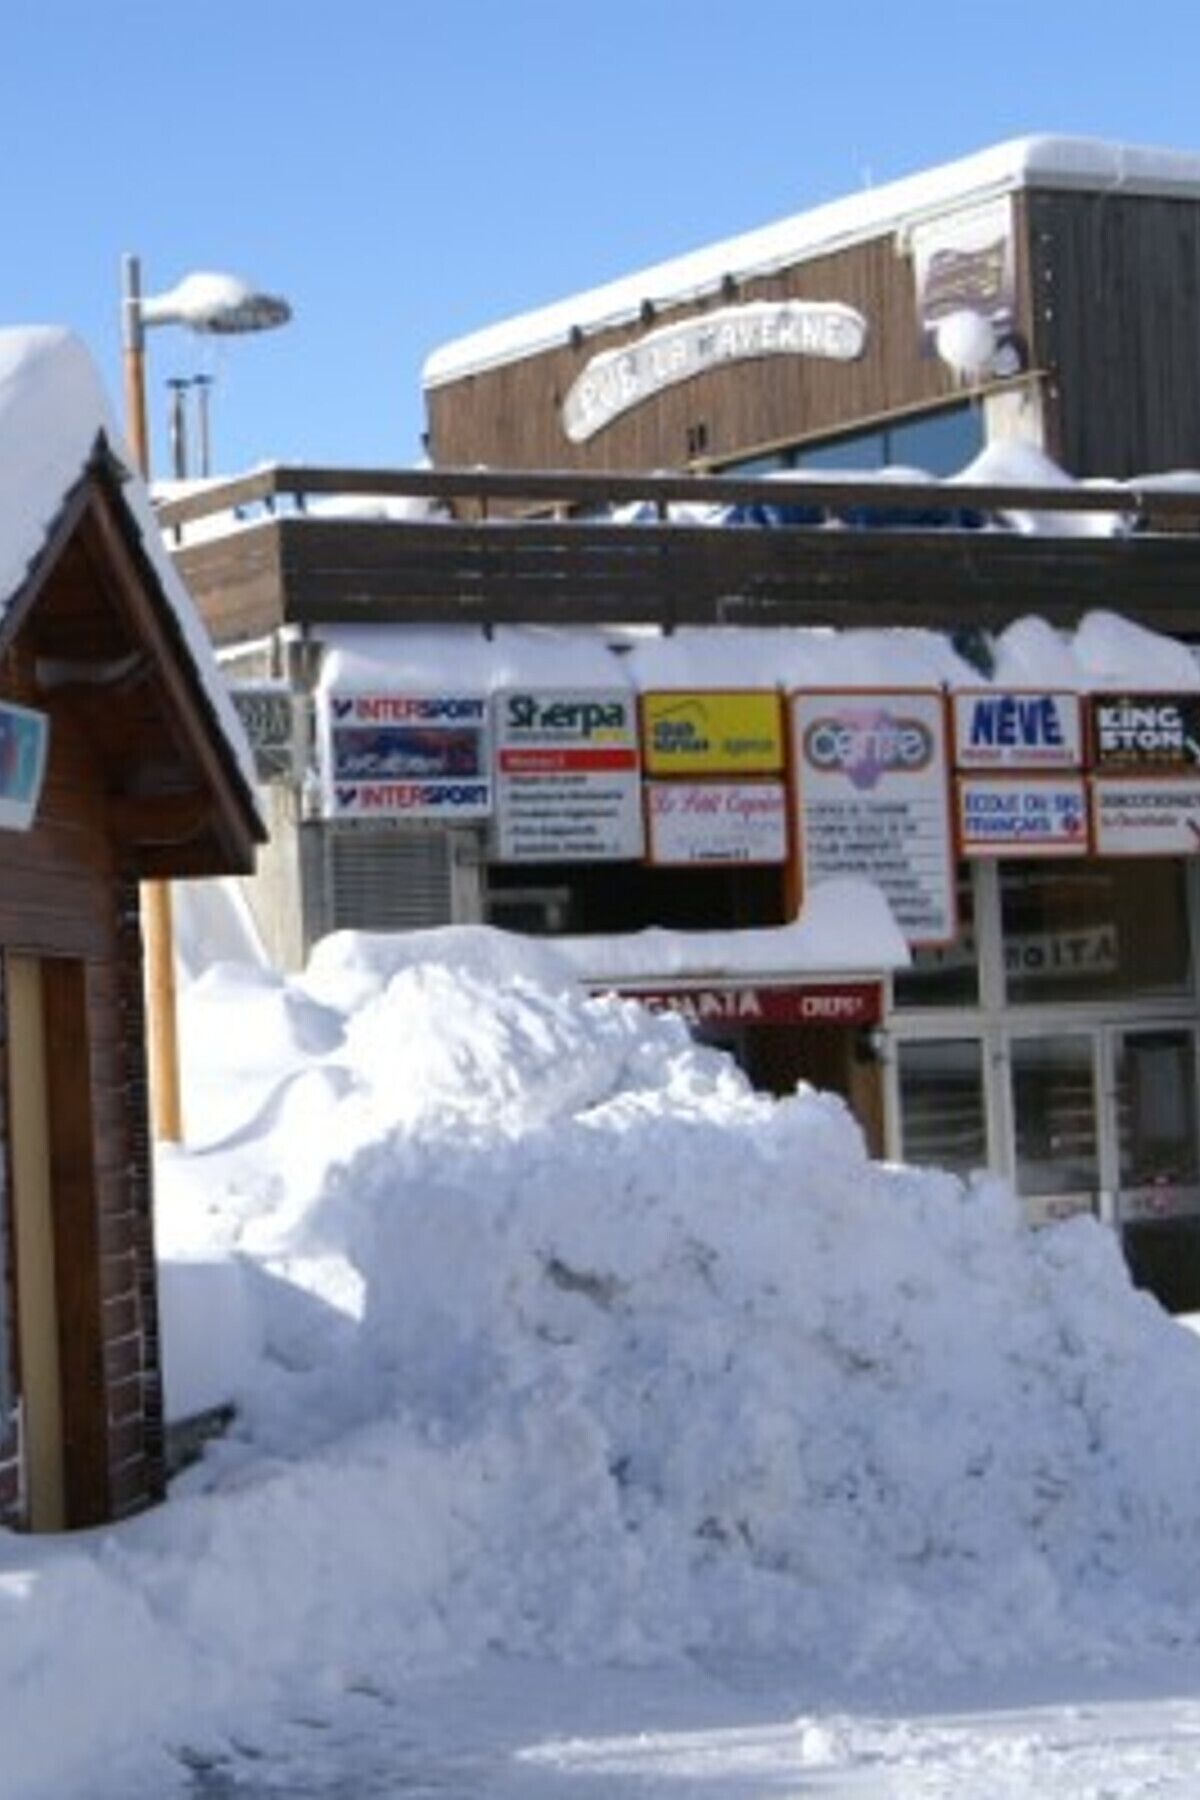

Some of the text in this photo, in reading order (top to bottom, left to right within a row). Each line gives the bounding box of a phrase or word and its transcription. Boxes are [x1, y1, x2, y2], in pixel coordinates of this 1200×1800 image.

[356, 698, 484, 720] INTERSPORT
[509, 695, 624, 738] Sherpa
[1101, 706, 1182, 729] KING
[1101, 730, 1183, 751] STON
[359, 784, 488, 806] INTERSPORT
